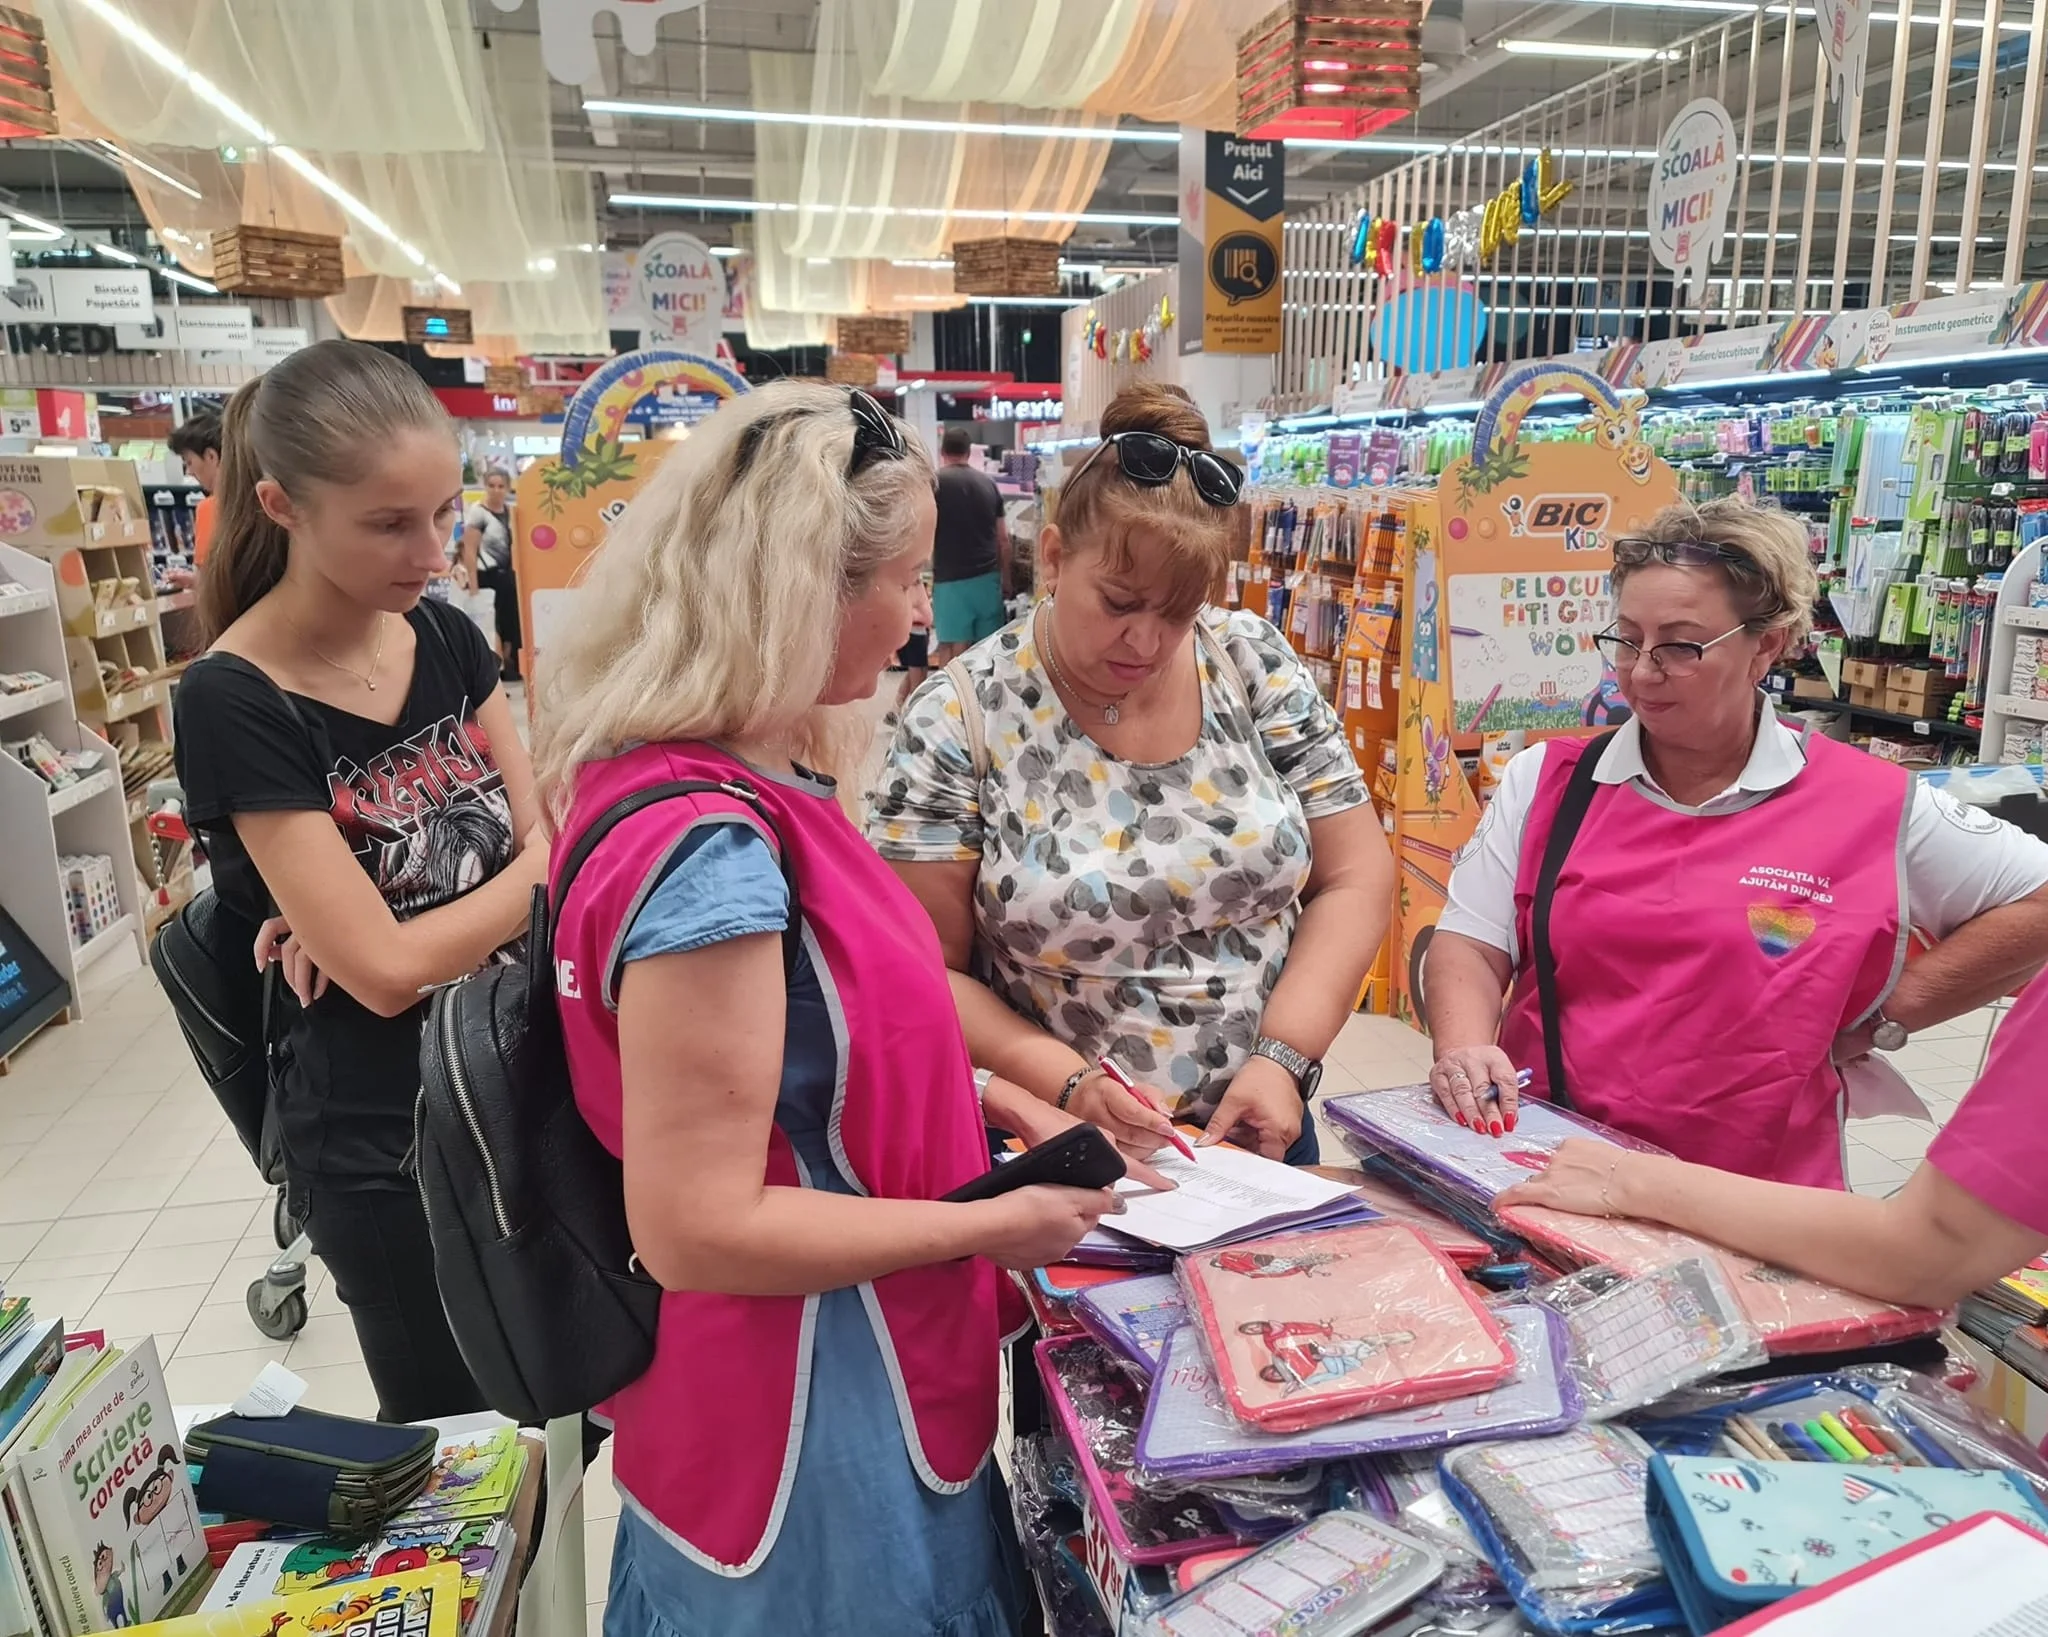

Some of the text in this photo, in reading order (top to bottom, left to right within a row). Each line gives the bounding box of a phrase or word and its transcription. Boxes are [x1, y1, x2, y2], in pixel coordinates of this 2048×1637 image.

[1224, 141, 1273, 162] Prețul
[1233, 163, 1263, 180] Aici
[1661, 188, 1714, 231] MICI!
[652, 292, 706, 311] MICI!
[1894, 312, 1995, 336] Instrumente geometrice
[1500, 576, 1527, 599] PE
[1749, 866, 1815, 884] ASOCIAȚIA
[1739, 876, 1833, 904] AJUTĂM DIN DEJ
[58, 1391, 125, 1473] Prima mea carte de
[73, 1401, 153, 1501] Scriere
[89, 1430, 154, 1520] corectă
[228, 1548, 265, 1602] de literatură
